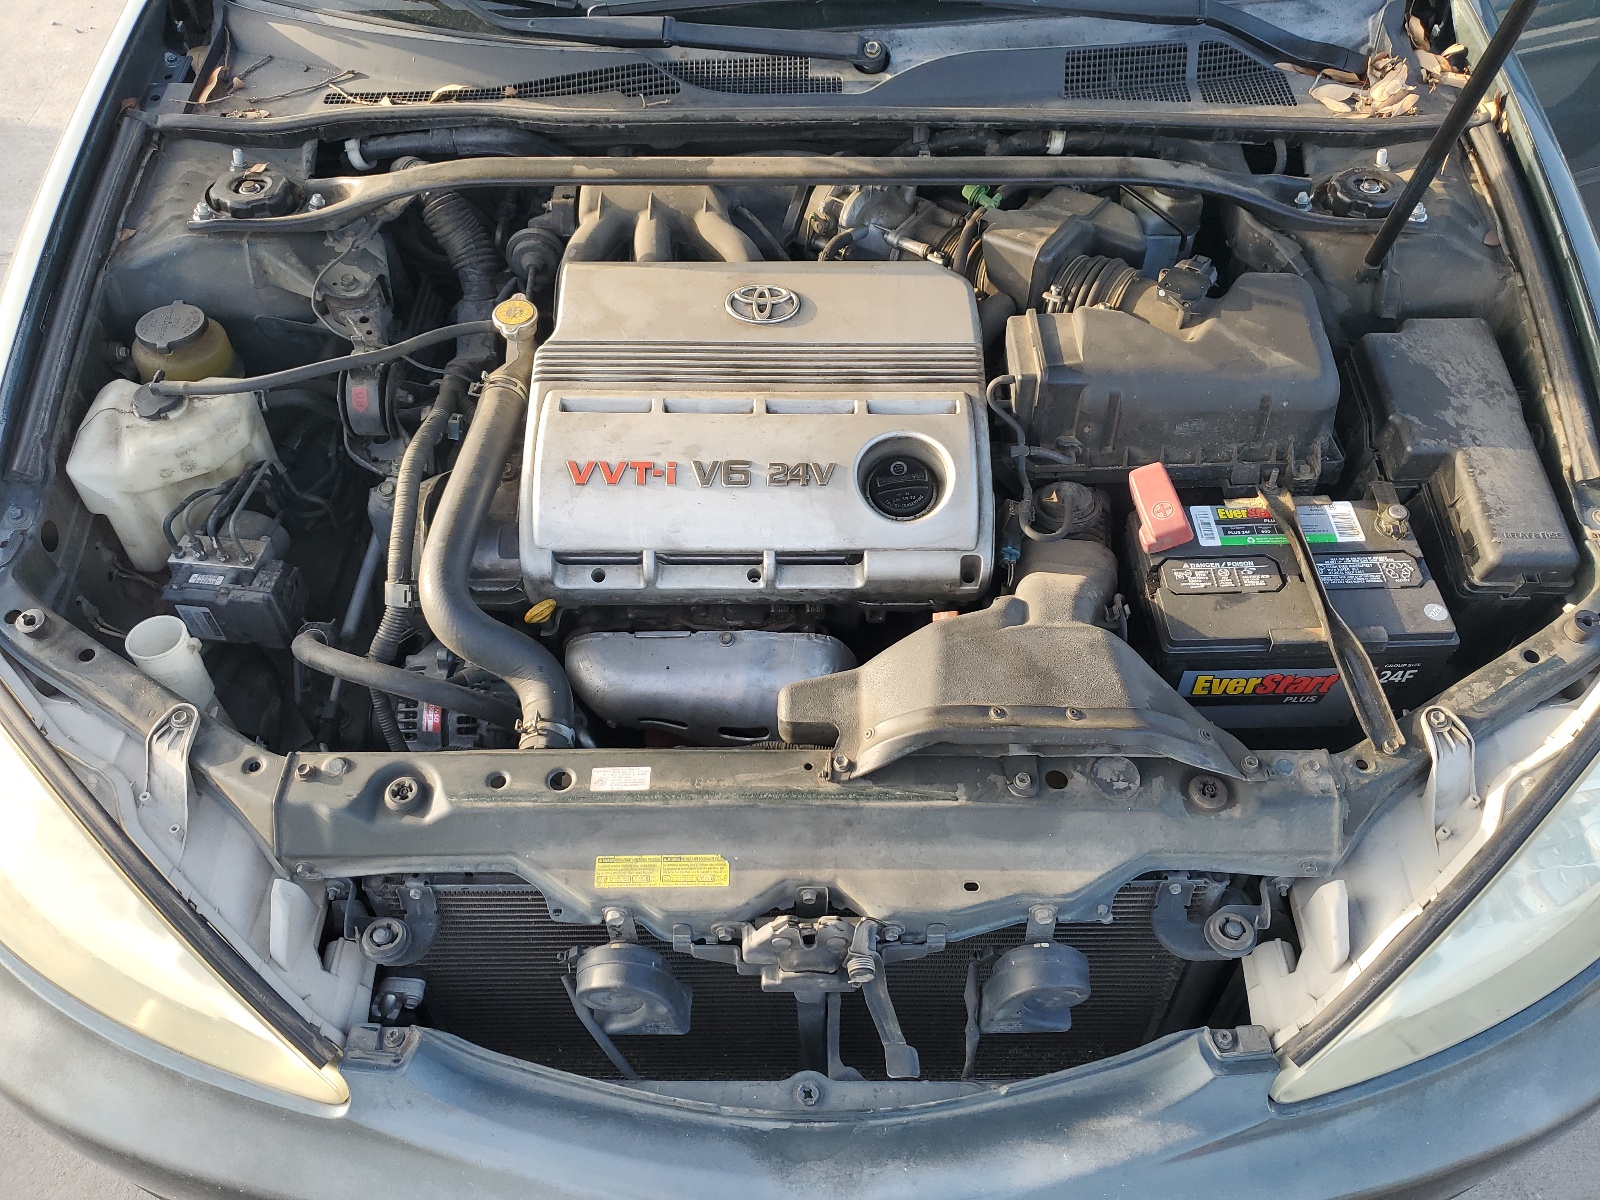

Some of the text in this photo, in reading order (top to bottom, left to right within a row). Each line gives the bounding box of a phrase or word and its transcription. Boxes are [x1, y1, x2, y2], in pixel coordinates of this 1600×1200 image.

[565, 459, 836, 488] VVT-i V6 24V
[1217, 507, 1272, 519] EverSta
[1191, 673, 1340, 695] EverStart
[1379, 669, 1419, 684] 24F
[1282, 695, 1318, 703] PLUS
